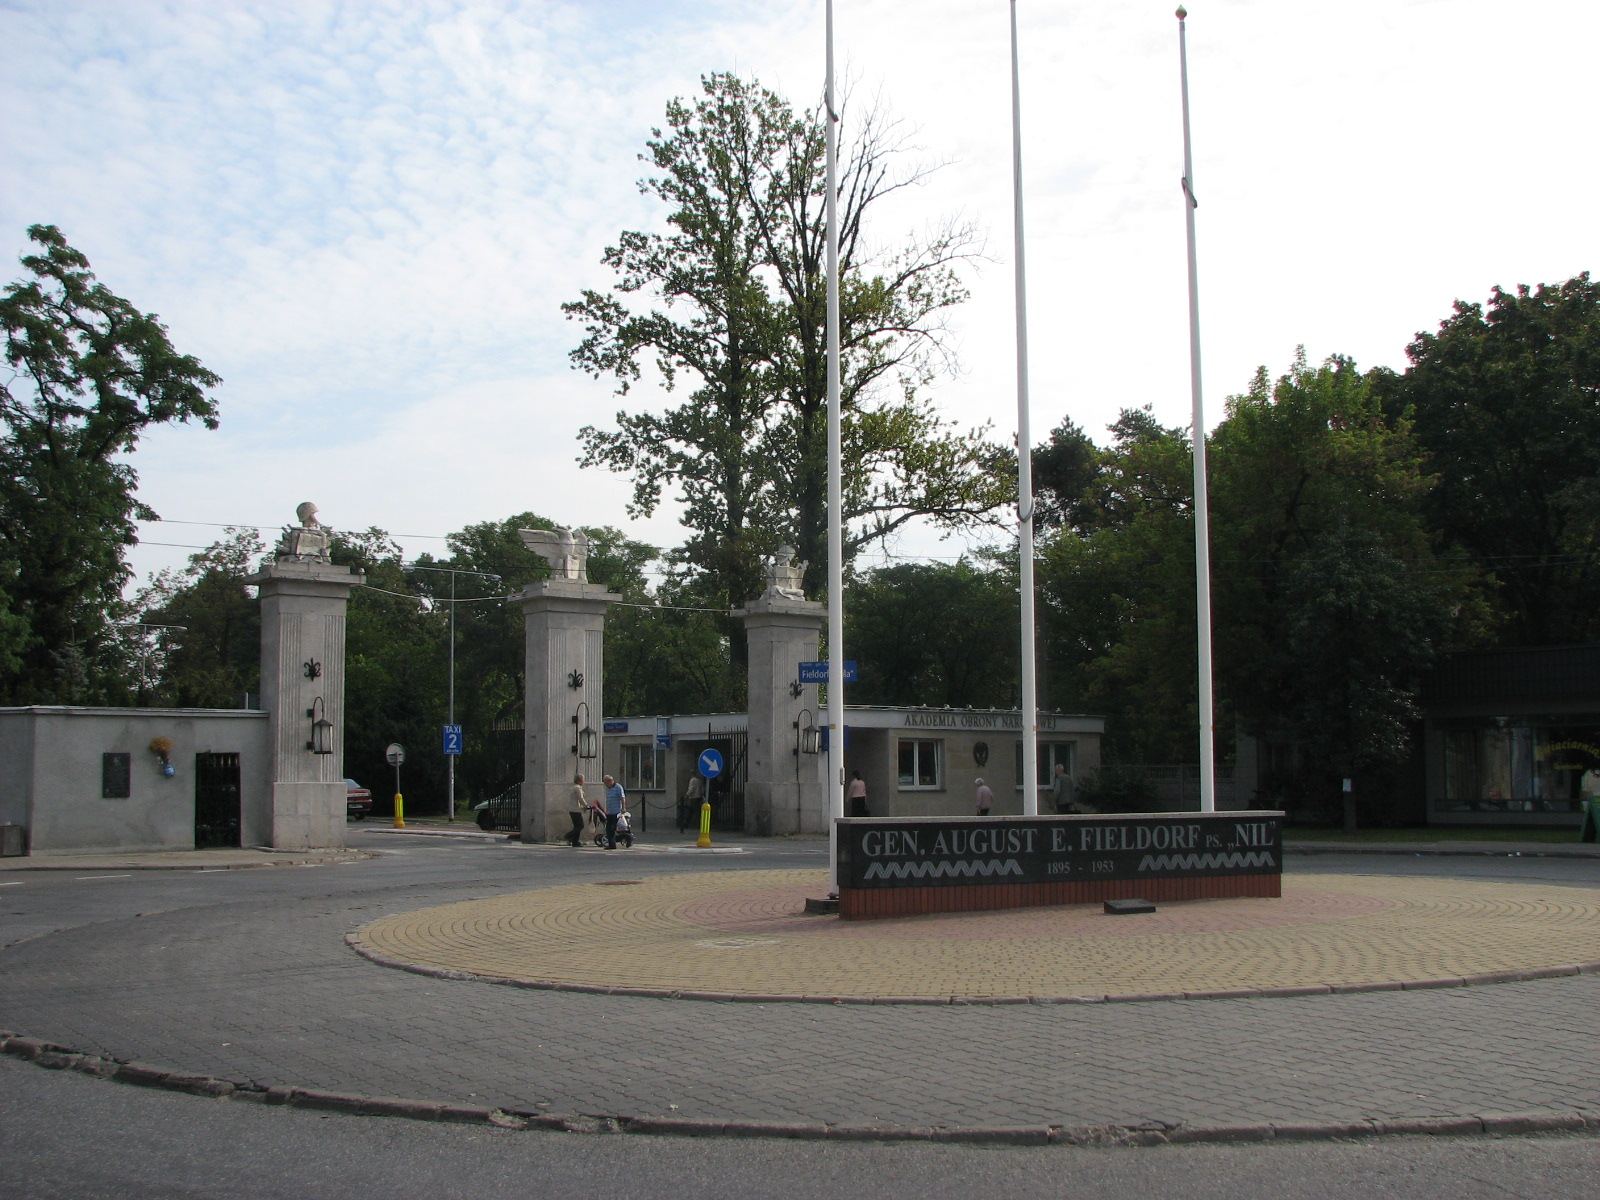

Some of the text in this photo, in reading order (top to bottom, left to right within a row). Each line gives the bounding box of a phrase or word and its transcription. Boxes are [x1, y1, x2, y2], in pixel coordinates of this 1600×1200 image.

[904, 713, 957, 727] AKADEMIA
[961, 714, 997, 728] OBRONY
[443, 725, 461, 734] TAXI
[449, 734, 457, 749] 2
[862, 830, 926, 857] GEN.
[931, 828, 1038, 855] AUGUST
[1051, 827, 1073, 852] E.
[1080, 825, 1200, 851] FIELDORF
[1205, 834, 1223, 848] PS.
[1047, 862, 1071, 874] 1895
[1091, 861, 1114, 873] 1953
